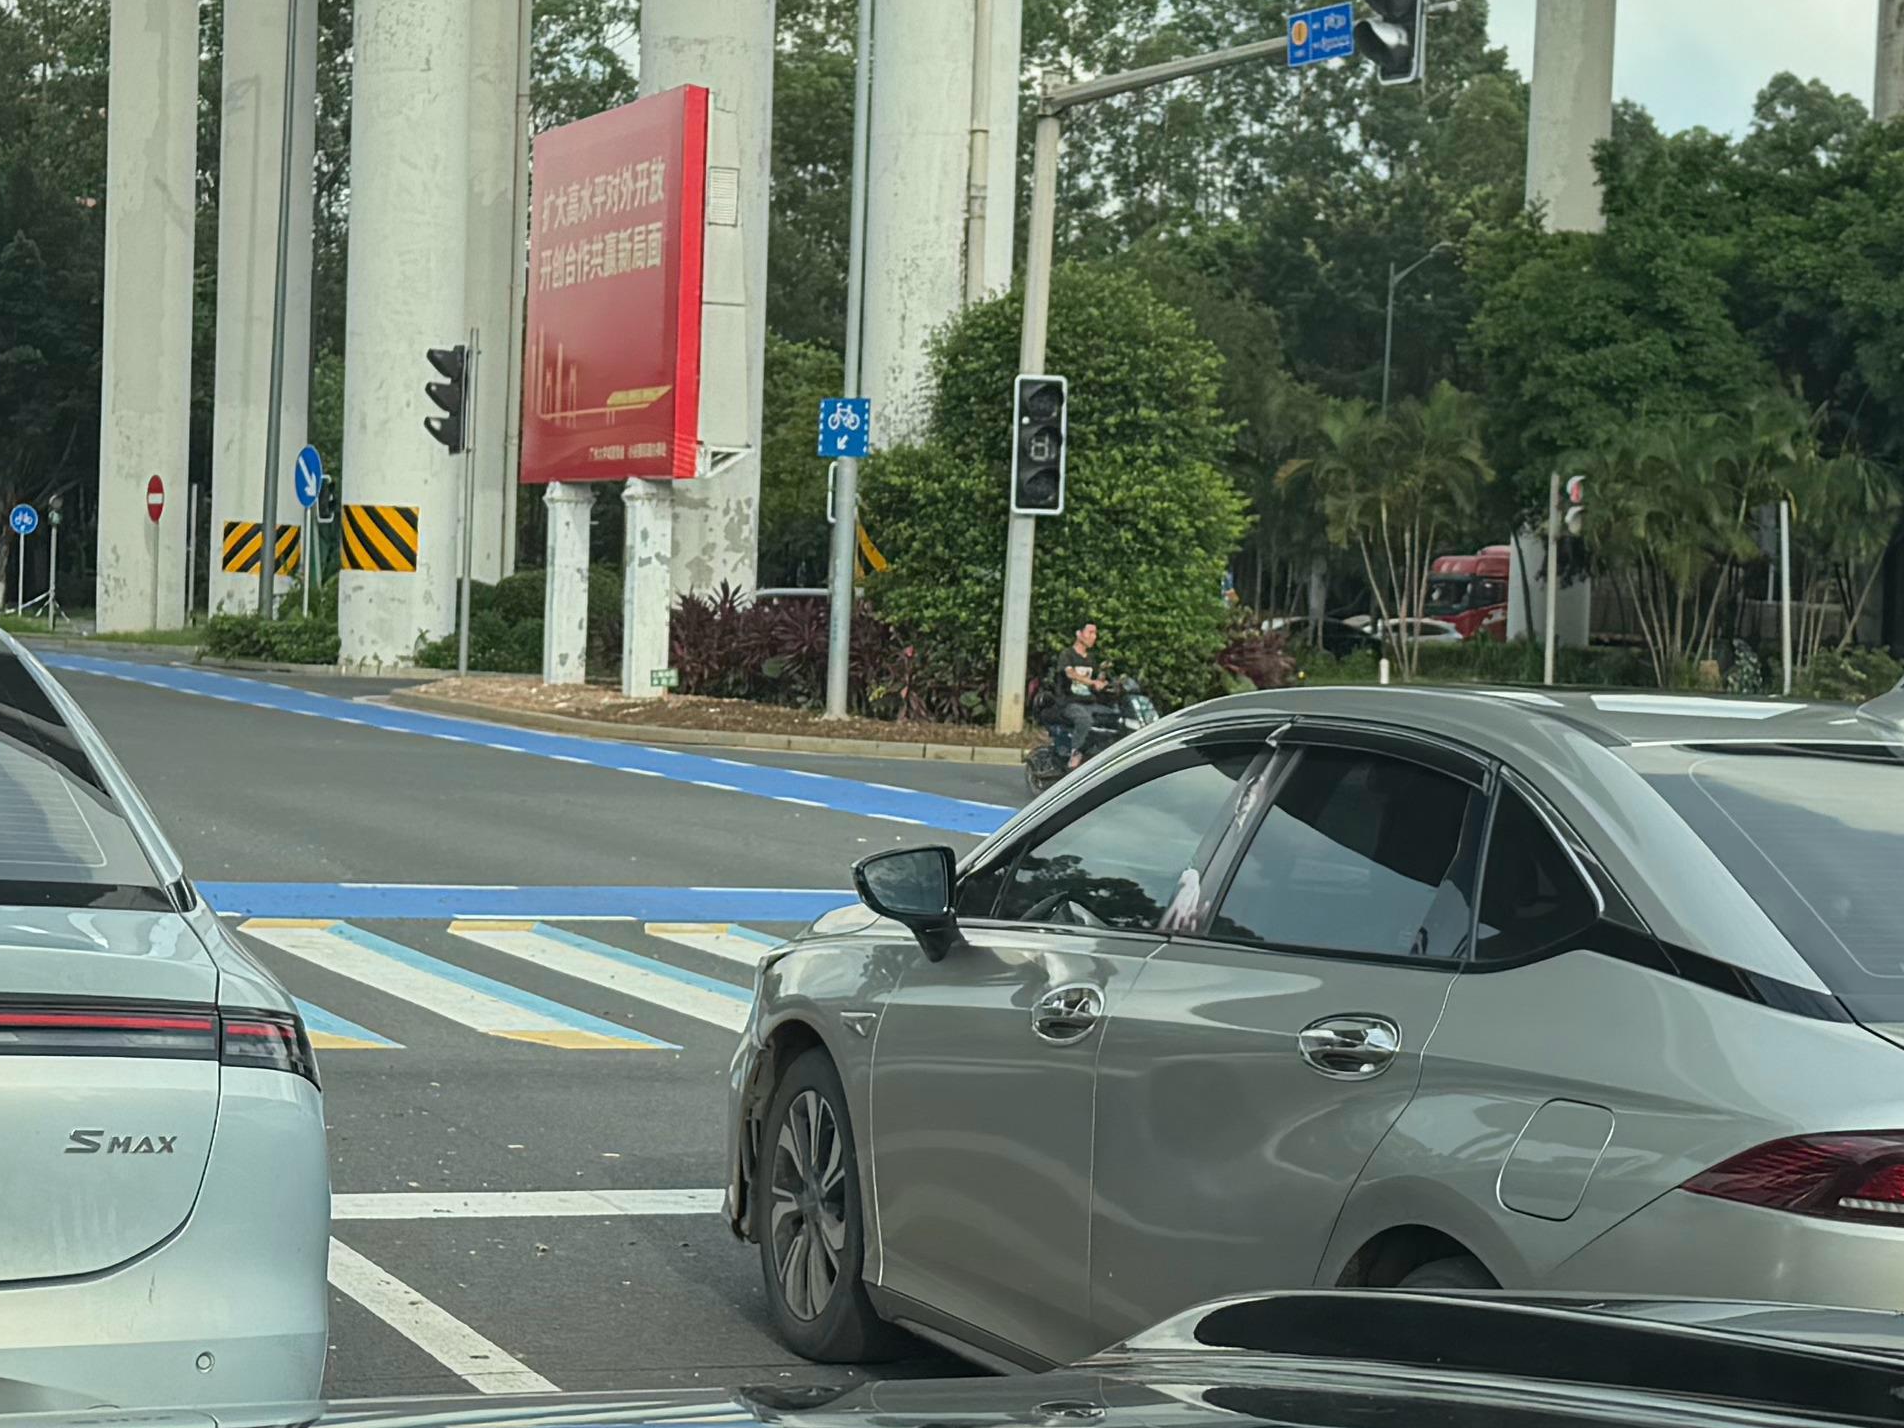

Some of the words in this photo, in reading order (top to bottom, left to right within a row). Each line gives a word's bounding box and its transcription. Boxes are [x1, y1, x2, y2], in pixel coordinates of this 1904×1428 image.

[542, 156, 666, 233] 扩大高水平对外开放
[539, 222, 663, 291] 开创合作共赢新局面
